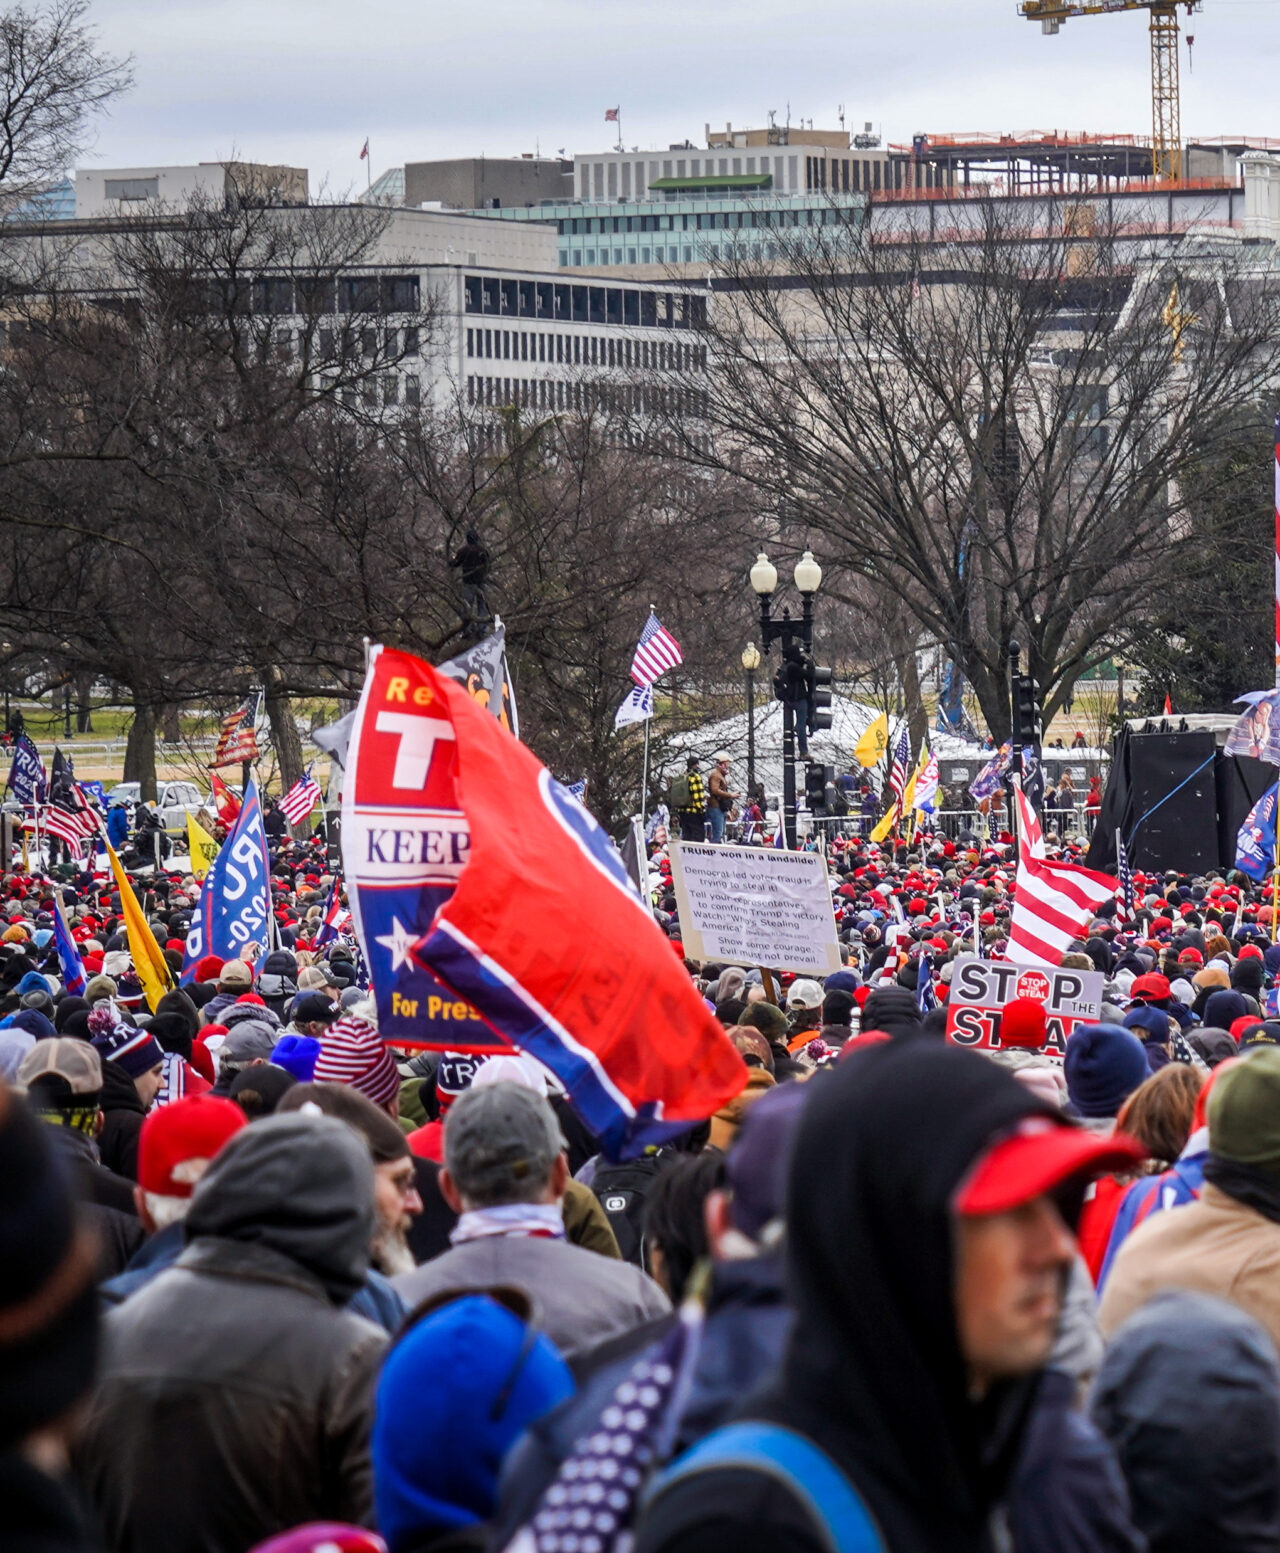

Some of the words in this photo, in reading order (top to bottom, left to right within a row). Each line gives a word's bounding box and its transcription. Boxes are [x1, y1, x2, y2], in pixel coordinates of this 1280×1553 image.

[386, 677, 434, 704] Re
[681, 846, 716, 857] TRUMP
[720, 851, 742, 860] won
[745, 852, 755, 860] in
[767, 854, 817, 866] landslide!
[684, 866, 730, 879] Democrat
[732, 871, 747, 879] led
[699, 878, 728, 889] trying
[731, 882, 741, 890] to
[743, 882, 765, 891] steal
[689, 889, 707, 899] Tell
[697, 901, 708, 909] to
[750, 907, 789, 919] Trump's
[760, 918, 800, 930] Stealing
[718, 936, 743, 946] Show
[746, 940, 771, 951] some
[719, 946, 738, 956] Evil
[740, 949, 763, 960] must
[764, 952, 782, 961] not
[1020, 976, 1047, 987] STOP
[1018, 989, 1047, 999] STEAL
[391, 992, 418, 1019] For
[1072, 1001, 1096, 1014] THE
[951, 1008, 1085, 1054] STA
